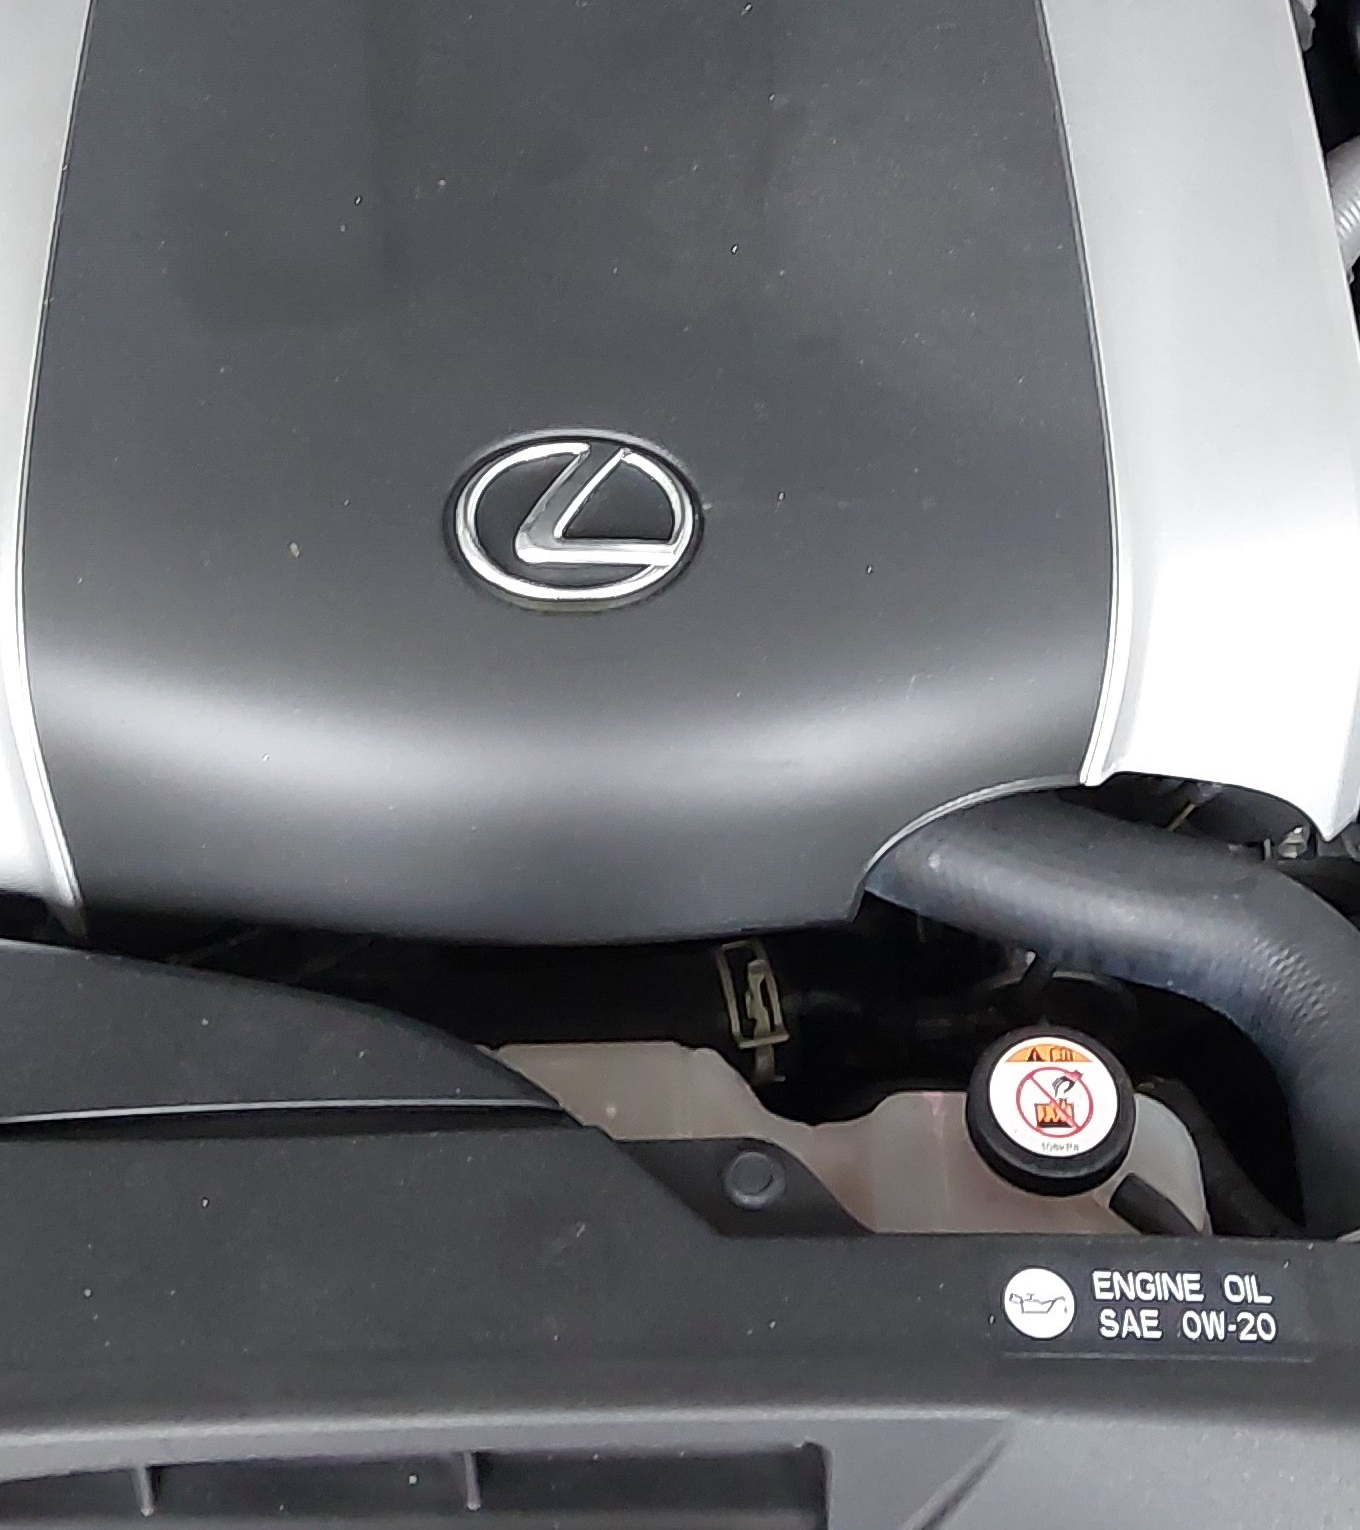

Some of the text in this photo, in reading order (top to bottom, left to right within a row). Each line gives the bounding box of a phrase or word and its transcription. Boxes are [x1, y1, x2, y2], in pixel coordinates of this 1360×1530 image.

[1091, 1269, 1274, 1305] ENGINE OIL
[1098, 1307, 1278, 1342] SAE 0W-20
